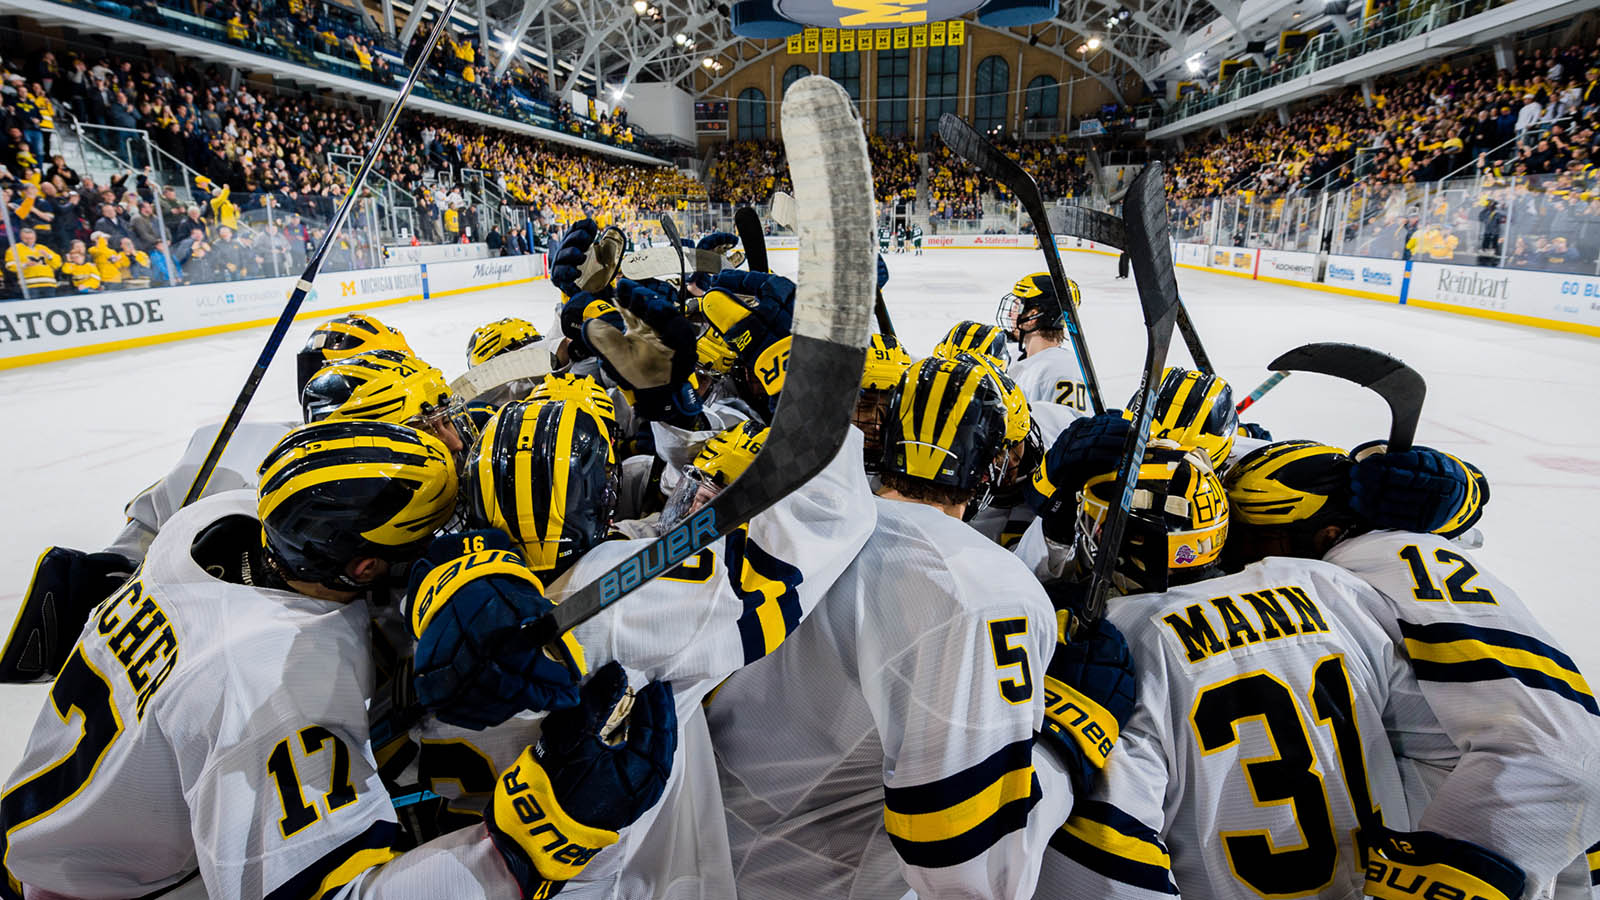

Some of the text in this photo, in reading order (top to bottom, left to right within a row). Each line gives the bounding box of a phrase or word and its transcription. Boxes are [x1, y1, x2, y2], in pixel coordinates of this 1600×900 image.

[928, 236, 954, 247] meijer
[340, 271, 421, 297] M MICHIGAN MEDICINE
[472, 261, 513, 280] Michigan
[1437, 268, 1511, 300] Reinhart
[1560, 280, 1579, 295] GO
[874, 349, 891, 361] 91
[1055, 380, 1087, 412] 20
[741, 439, 762, 454] 16
[462, 535, 485, 554] 16
[1397, 543, 1501, 607] 12
[1162, 585, 1331, 666] MANN
[987, 615, 1033, 706] 5
[266, 724, 359, 841] 17
[1188, 652, 1387, 900] 31
